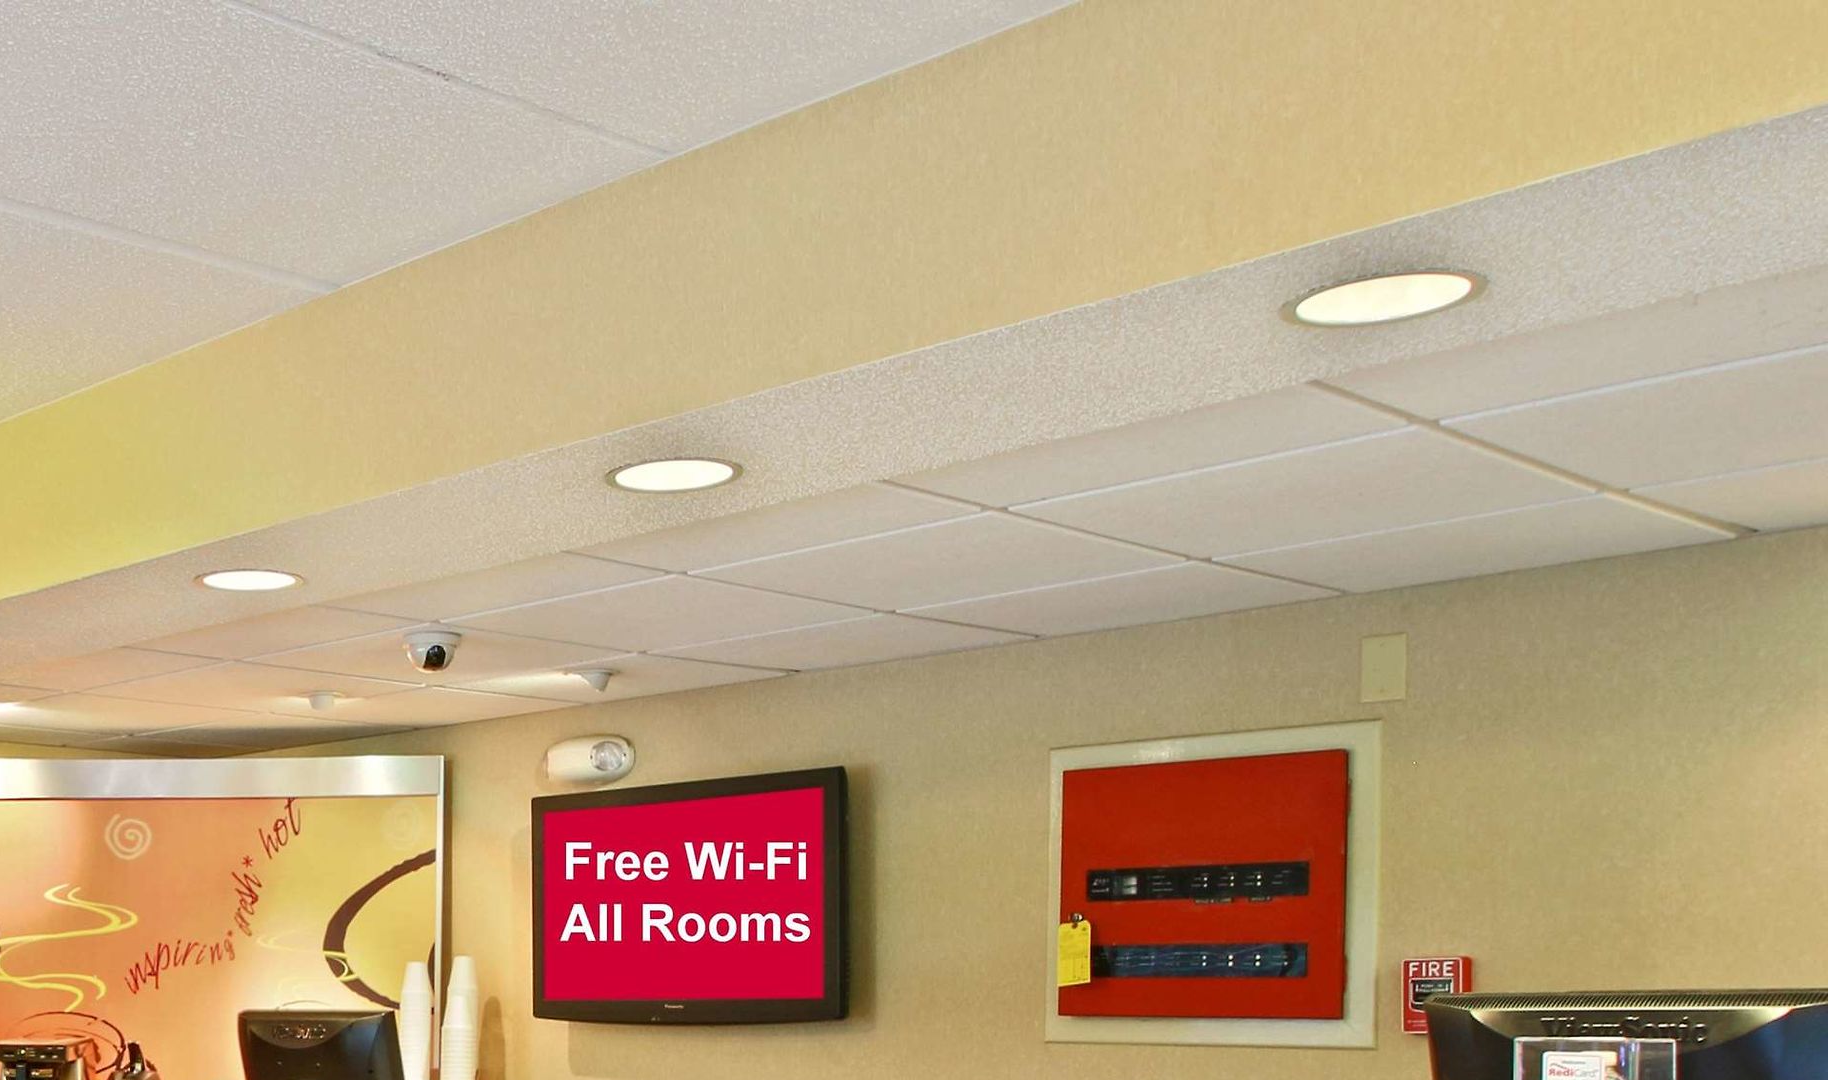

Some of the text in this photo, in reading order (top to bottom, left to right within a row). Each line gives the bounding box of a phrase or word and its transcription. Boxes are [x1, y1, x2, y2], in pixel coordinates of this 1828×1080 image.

[258, 796, 302, 860] hot
[564, 841, 808, 881] Free Wi-Fi
[559, 903, 812, 943] All Rooms
[1408, 960, 1455, 978] FIRE
